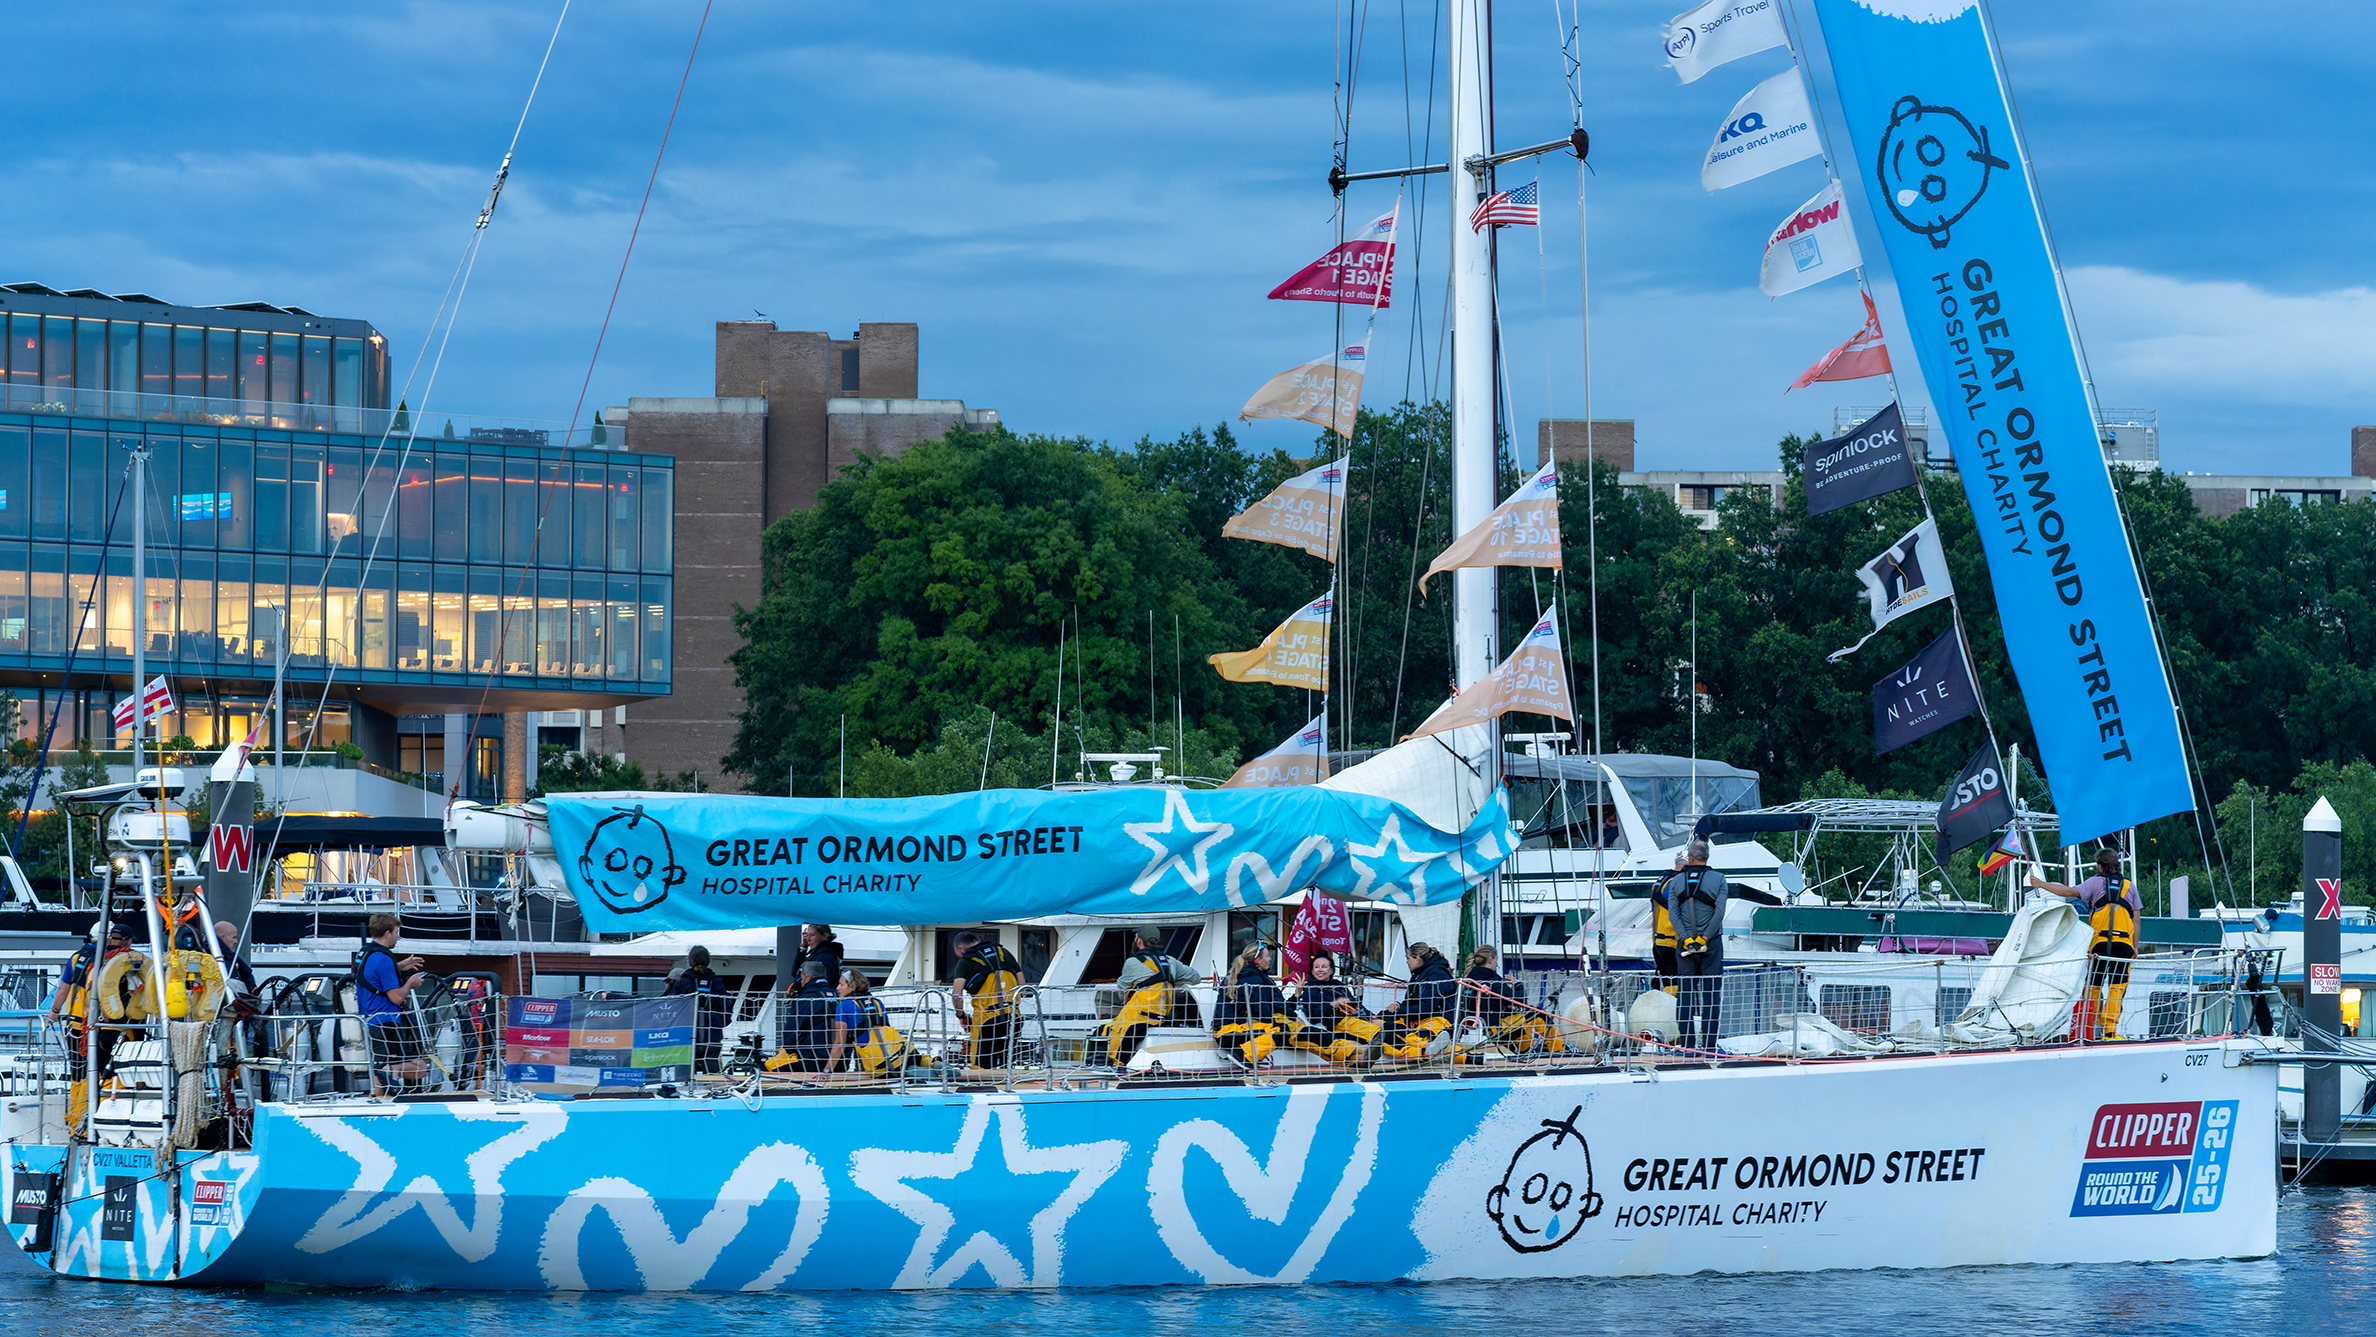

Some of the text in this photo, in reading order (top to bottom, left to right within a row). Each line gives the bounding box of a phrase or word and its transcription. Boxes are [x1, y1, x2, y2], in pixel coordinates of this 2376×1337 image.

[1700, 0, 1770, 34] Sports Travel
[1671, 33, 1690, 52] ATPI
[1720, 112, 1767, 143] KQ
[1746, 135, 1768, 151] and
[1769, 122, 1808, 142] Marine
[1772, 200, 1839, 246] rlow
[1932, 272, 2032, 557] HOSPITAL CHARITY
[1815, 453, 1902, 489] BE ADVENTURE-PROOF
[1963, 258, 2132, 763] GREAT ORMOND STREET
[1887, 680, 1949, 723] NITE
[1908, 709, 1938, 727] WATCHES
[1950, 767, 1998, 811] STO
[211, 823, 253, 873] W
[705, 825, 1084, 866] GREAT ORMOND STREET
[702, 874, 922, 895] HOSPITAL CHARITY
[2314, 878, 2340, 920] X
[2320, 985, 2337, 993] ZONE
[527, 1004, 555, 1012] CLIPPER
[585, 1010, 620, 1018] MUSTO
[2185, 1054, 2209, 1067] CV27
[2096, 1112, 2192, 1148] CLIPPER
[93, 1153, 153, 1168] CV27 VALLETTA
[1623, 1147, 1985, 1193] GREAT ORMOND STREET
[2192, 1107, 2232, 1205] 25-26
[196, 1185, 223, 1199] CLIPPER
[2086, 1171, 2159, 1186] ROUND THE
[15, 1189, 47, 1204] MUSTO
[2083, 1185, 2156, 1206] WORLD
[106, 1209, 133, 1223] NITE
[1615, 1201, 1827, 1227] HOSPITAL CHARITY
